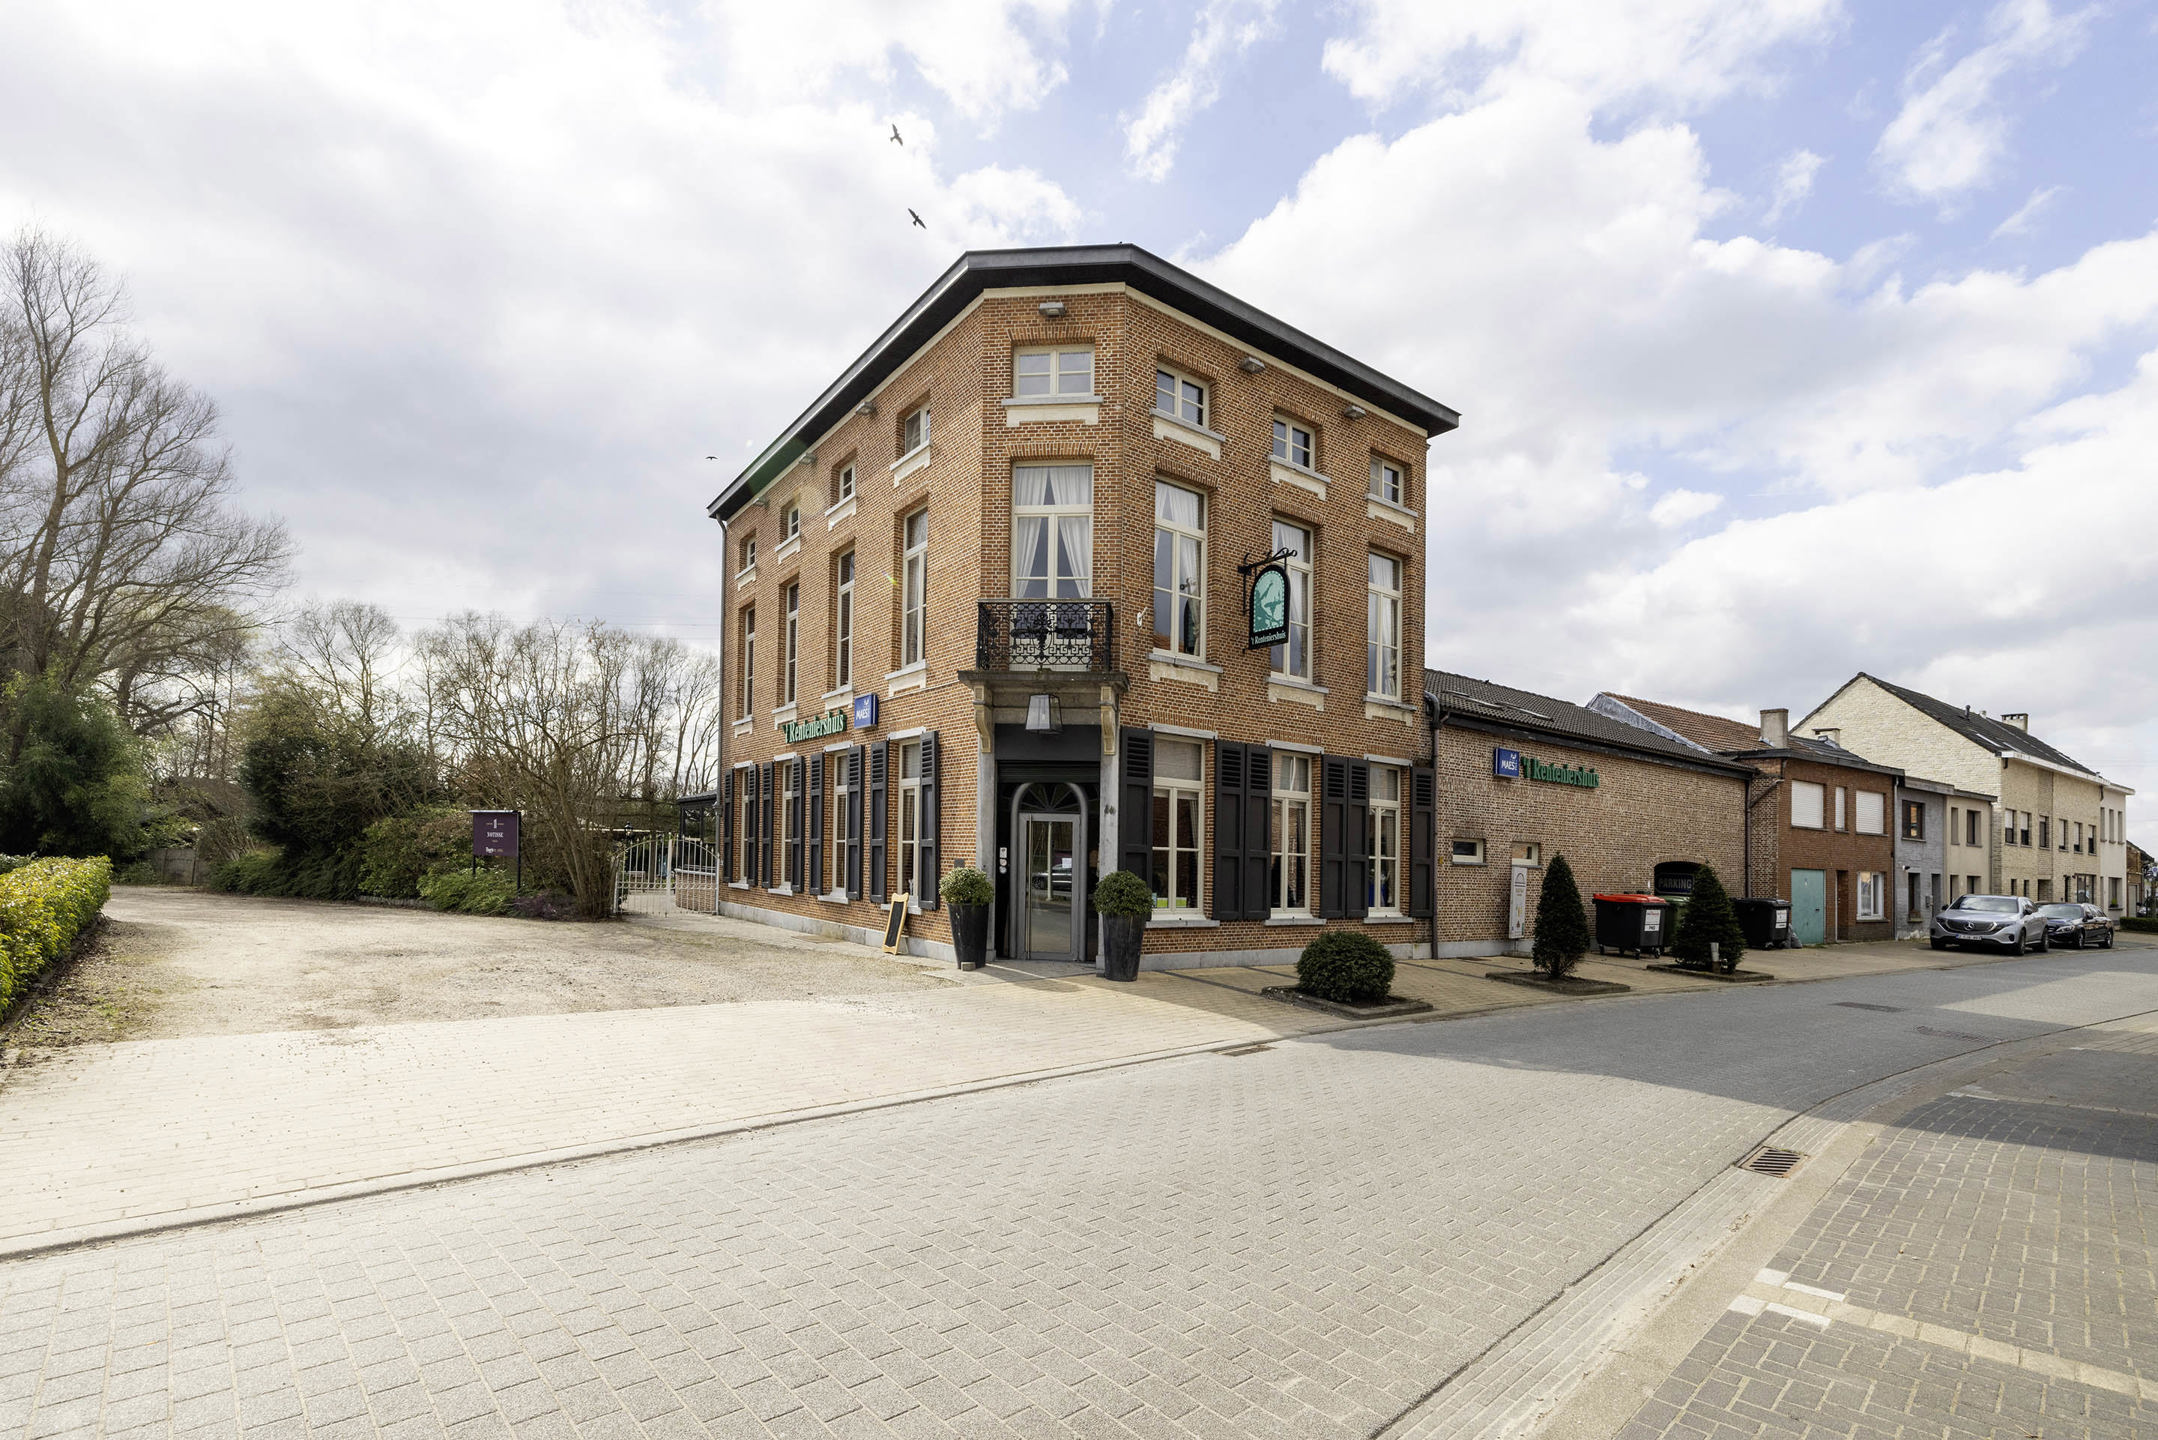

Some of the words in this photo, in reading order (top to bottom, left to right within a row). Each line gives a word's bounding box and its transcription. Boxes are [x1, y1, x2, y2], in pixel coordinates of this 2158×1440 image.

[788, 709, 847, 743] Renteniershuis
[1501, 759, 1515, 771] MAES
[1531, 758, 1599, 789] Renteniershuis
[1658, 877, 1692, 889] PARKING
